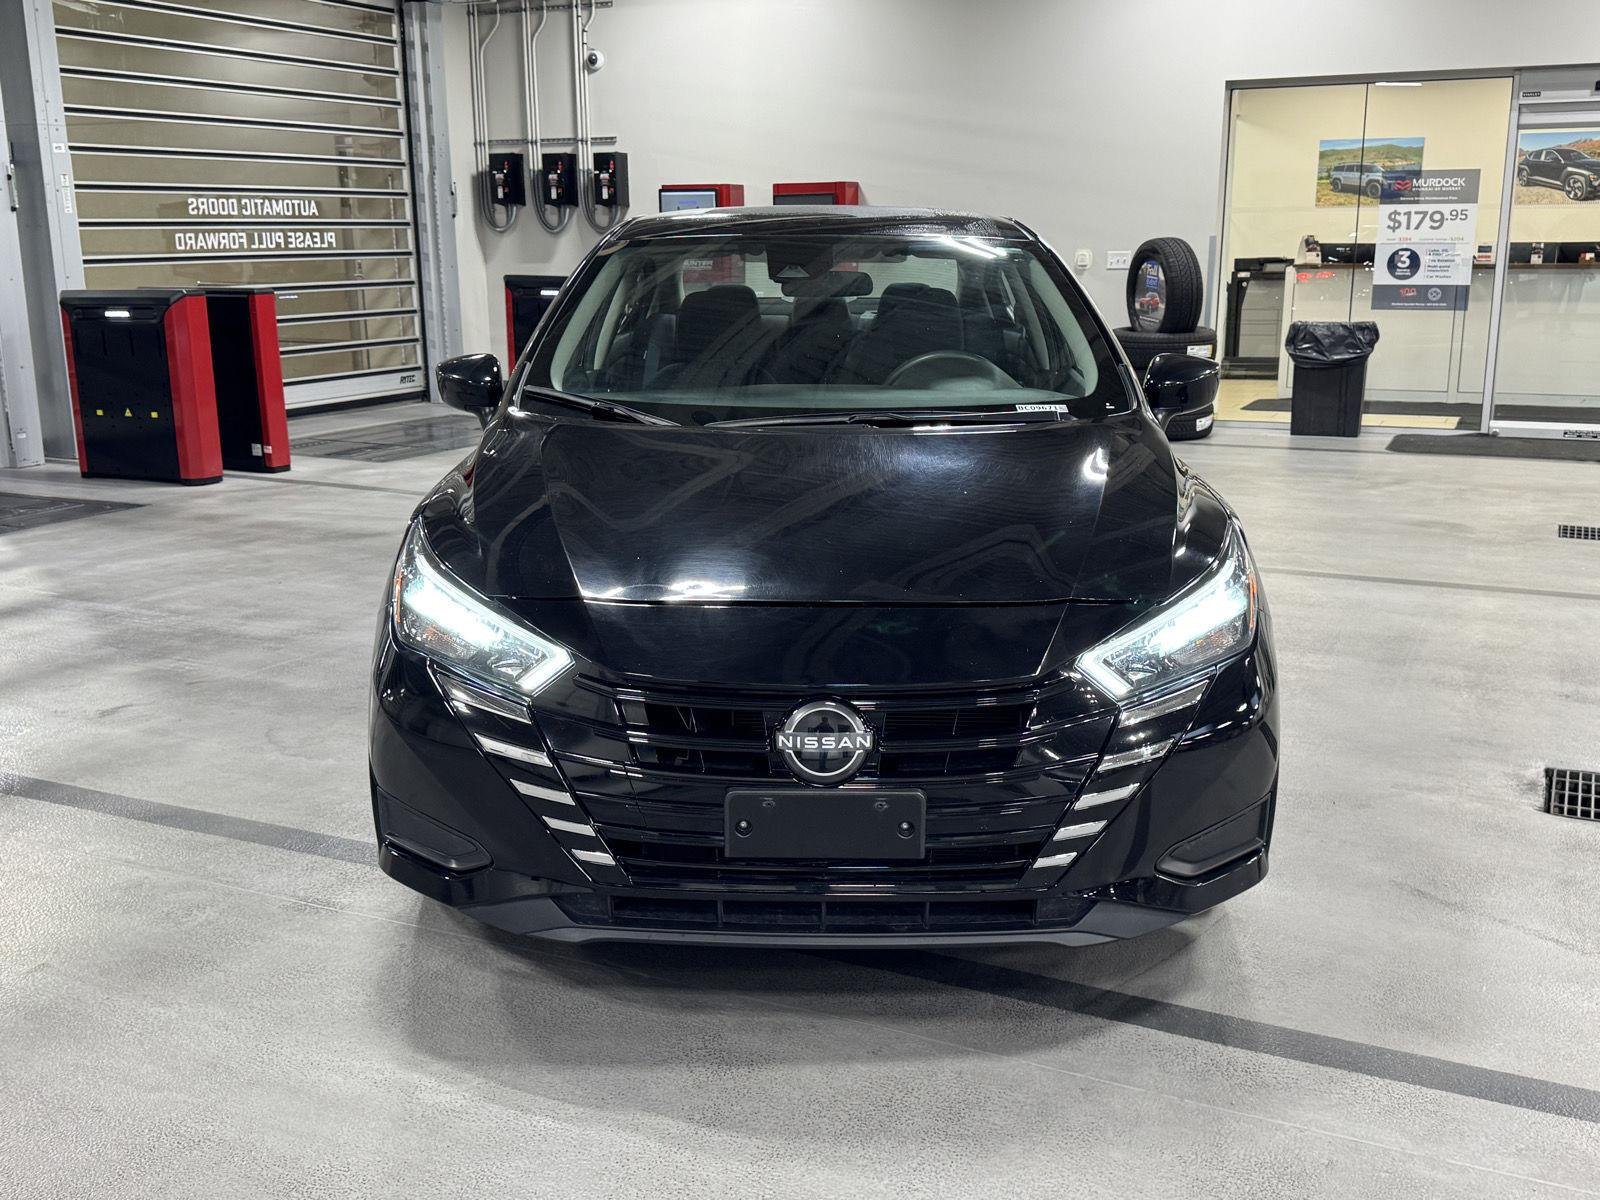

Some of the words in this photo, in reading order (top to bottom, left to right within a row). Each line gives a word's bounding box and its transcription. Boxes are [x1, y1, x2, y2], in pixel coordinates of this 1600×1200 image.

[1412, 177, 1466, 187] MURDOCK
[1396, 250, 1412, 268] 3
[778, 734, 872, 749] NISSAN
